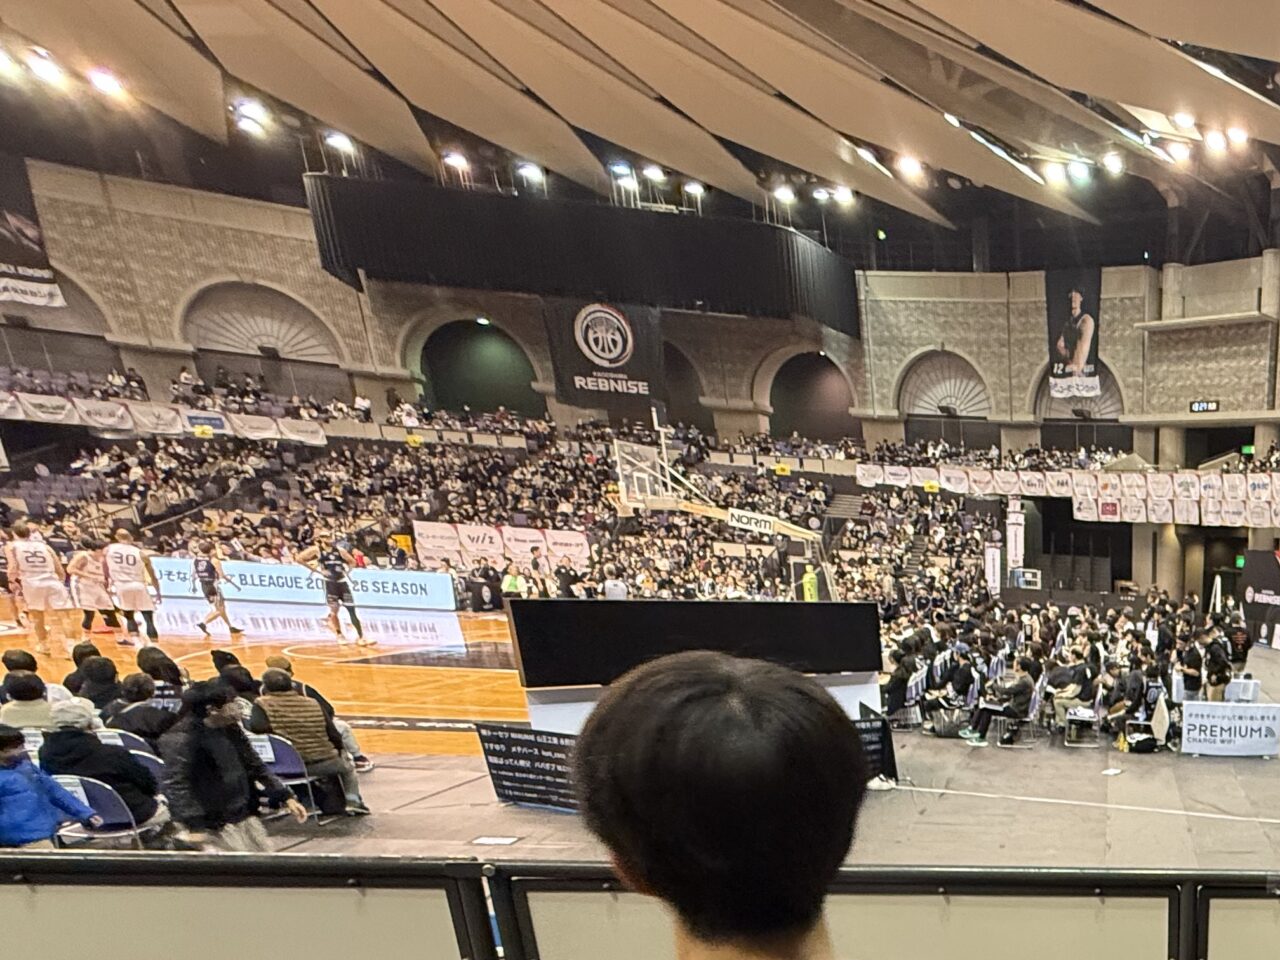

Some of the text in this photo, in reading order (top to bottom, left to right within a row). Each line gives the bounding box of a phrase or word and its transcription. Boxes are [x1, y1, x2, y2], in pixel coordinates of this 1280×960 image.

[574, 376, 650, 395] REBNISE
[730, 511, 772, 530] NORM
[24, 550, 46, 564] 25
[114, 551, 137, 566] 30
[371, 581, 428, 596] SEASON
[1187, 723, 1262, 739] PREMIUM
[1187, 736, 1217, 745] CHARGE
